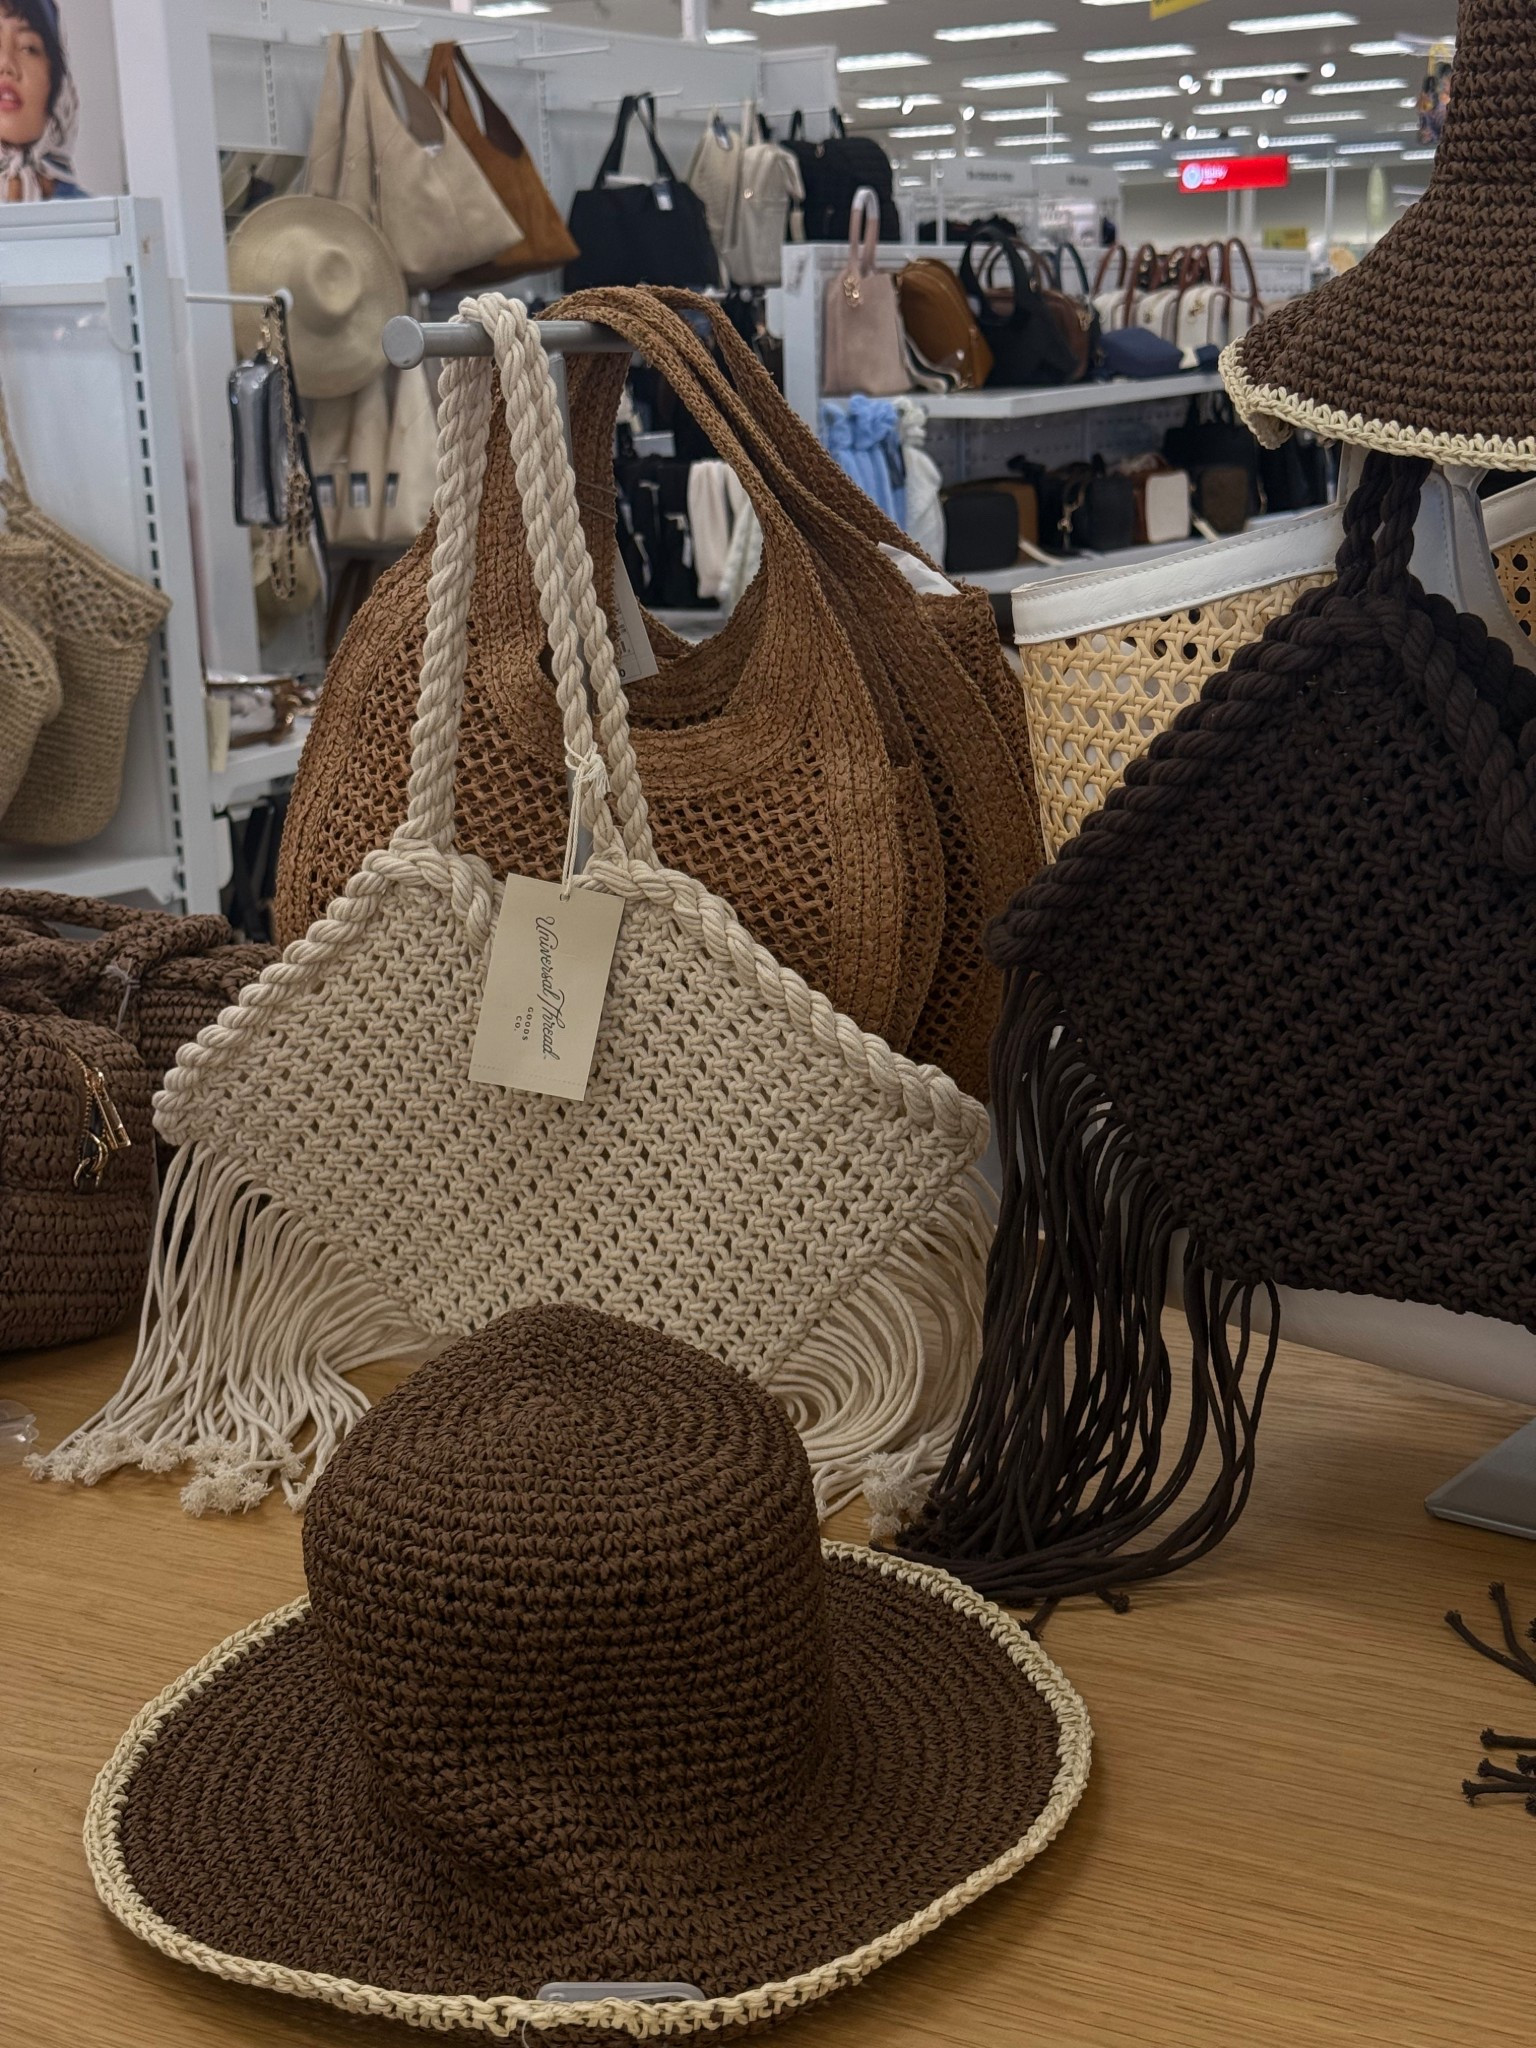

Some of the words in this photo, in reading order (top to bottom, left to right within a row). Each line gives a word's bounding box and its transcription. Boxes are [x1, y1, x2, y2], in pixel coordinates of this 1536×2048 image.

[535, 916, 560, 1001] Universal
[513, 1015, 523, 1031] CO.
[521, 1006, 534, 1041] GOODS
[536, 988, 566, 1060] Thread
